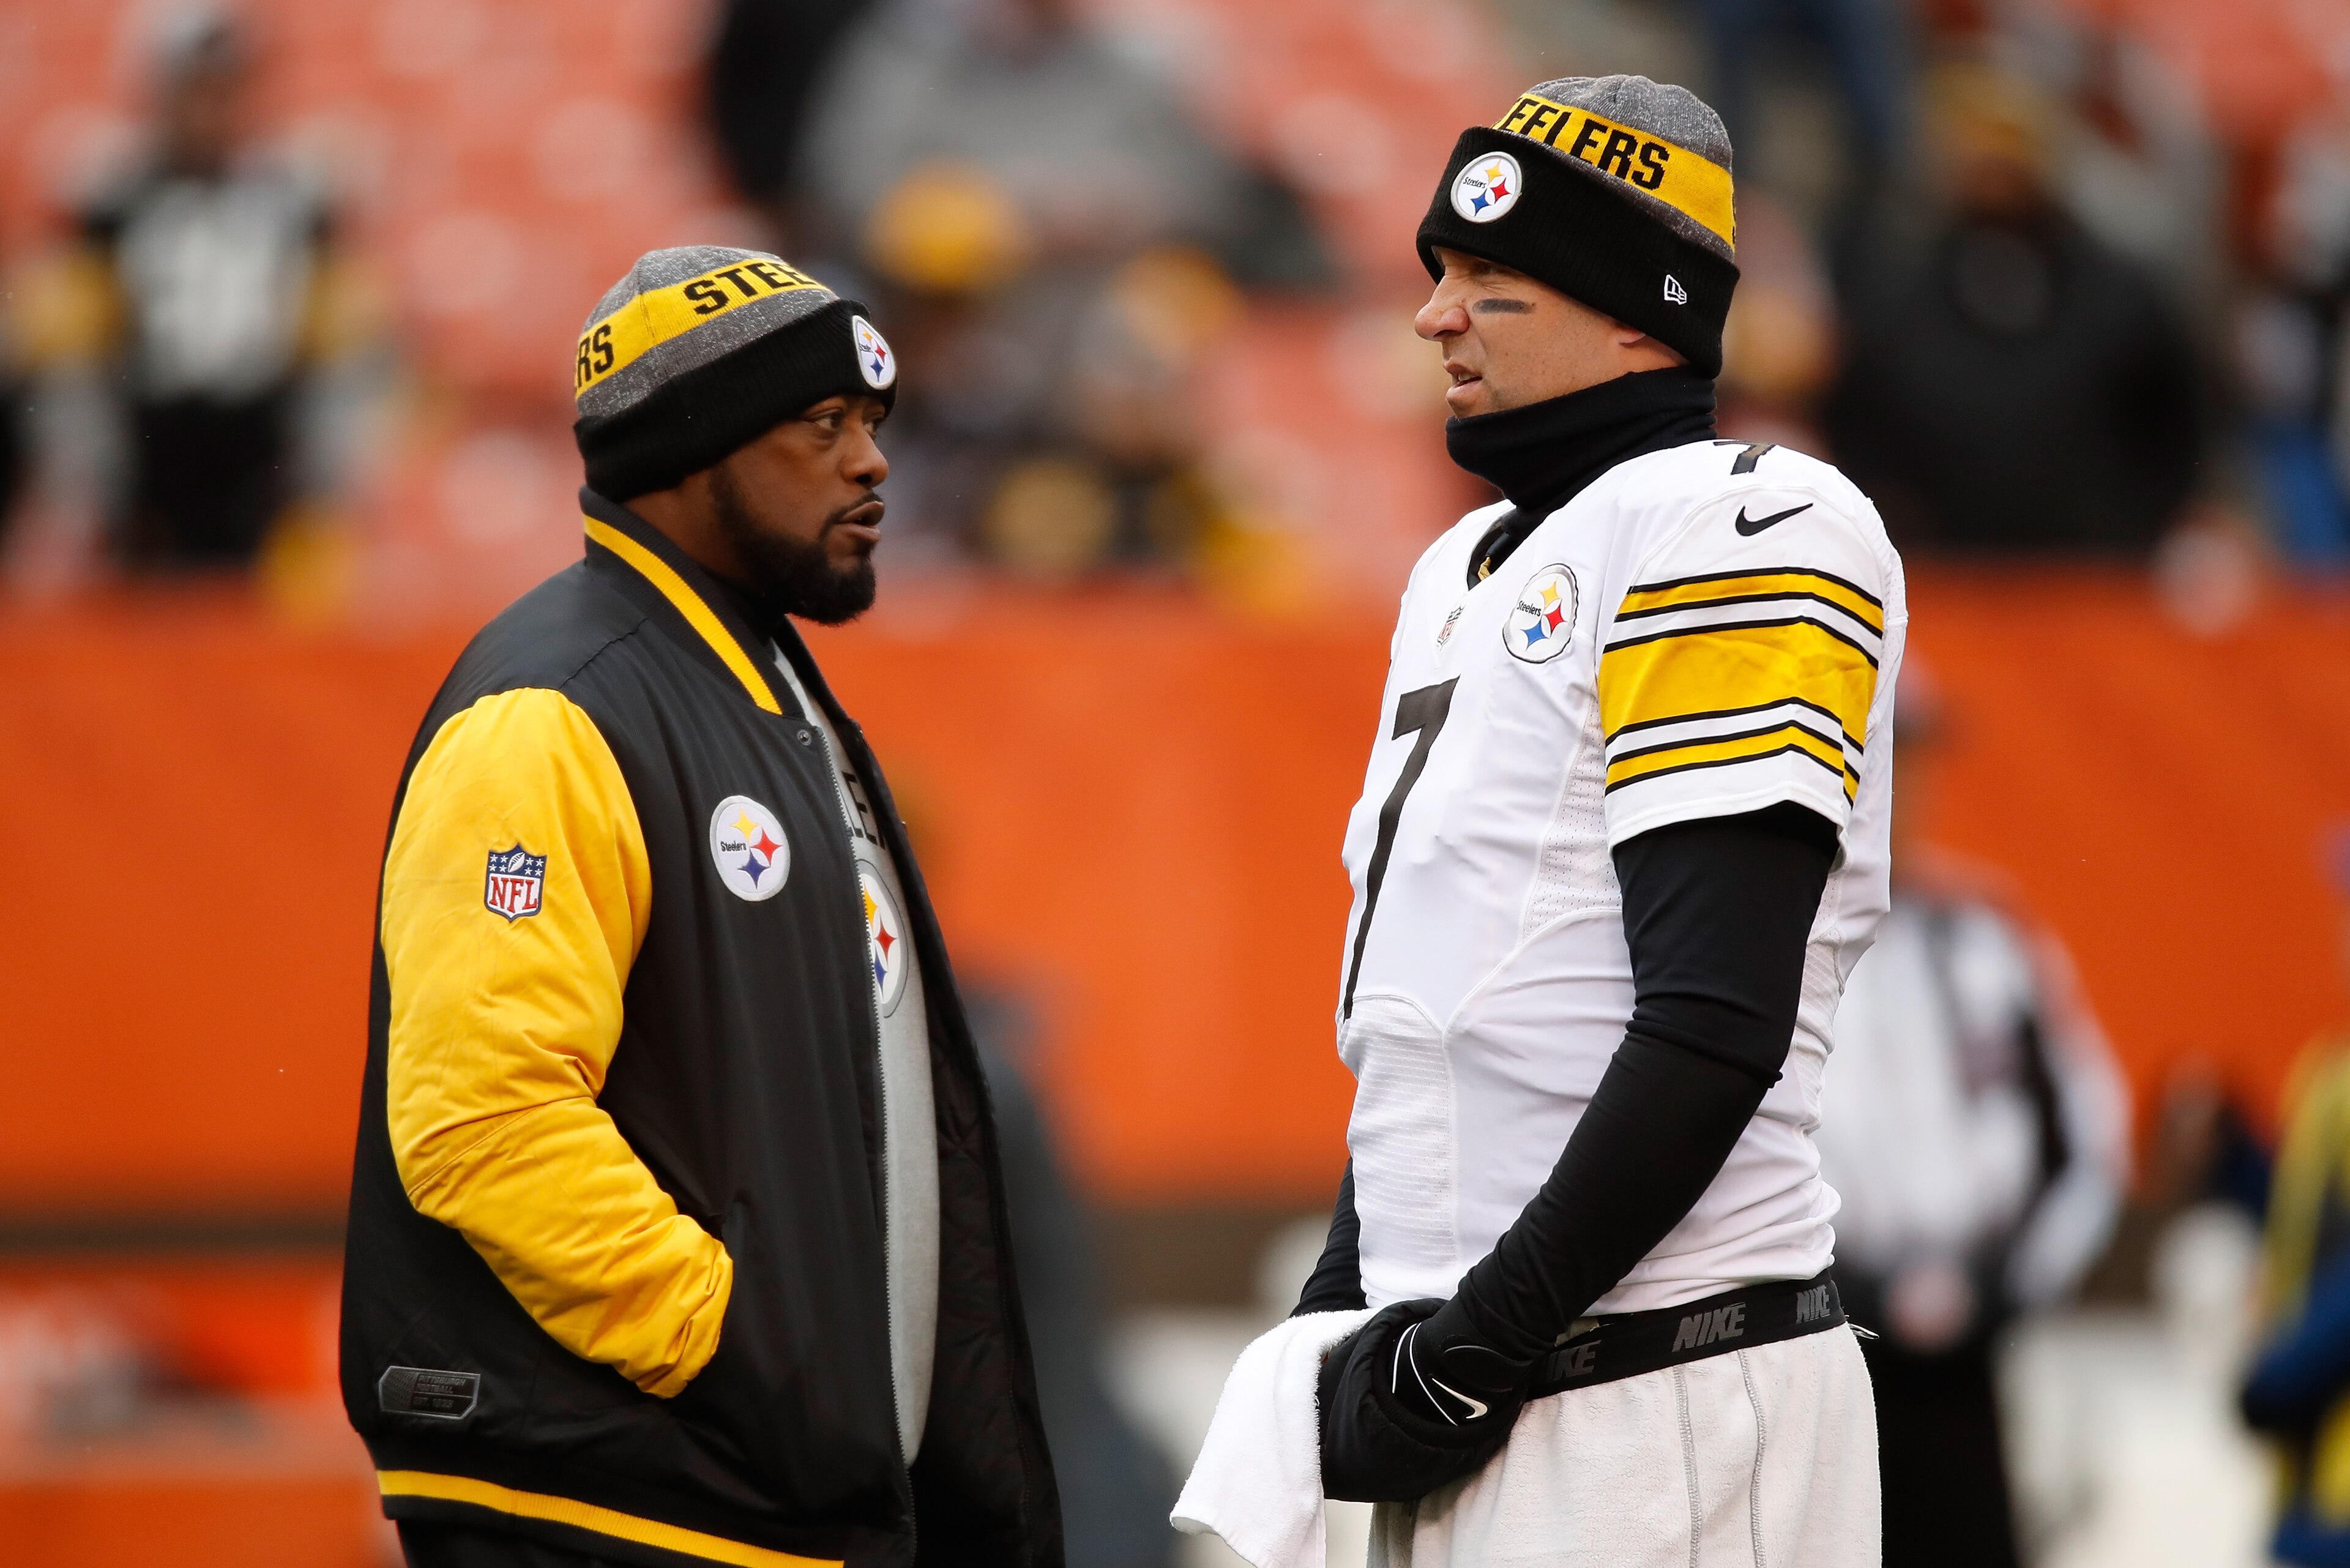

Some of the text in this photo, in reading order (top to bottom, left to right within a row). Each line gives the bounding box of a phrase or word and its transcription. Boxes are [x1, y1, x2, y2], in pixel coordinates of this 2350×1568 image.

[1491, 97, 1670, 190] EELERS
[1713, 440, 1777, 475] 7
[1516, 600, 1542, 617] Steelers
[720, 840, 747, 852] Steelers
[1343, 673, 1461, 1024] 7
[488, 876, 539, 913] NFL
[1796, 1285, 1831, 1324] NIKE
[1671, 1302, 1746, 1353] NIKE
[1545, 1339, 1602, 1382] IKE
[416, 1383, 453, 1393] FOOTBALL
[419, 1375, 466, 1386] PITTSBURGH
